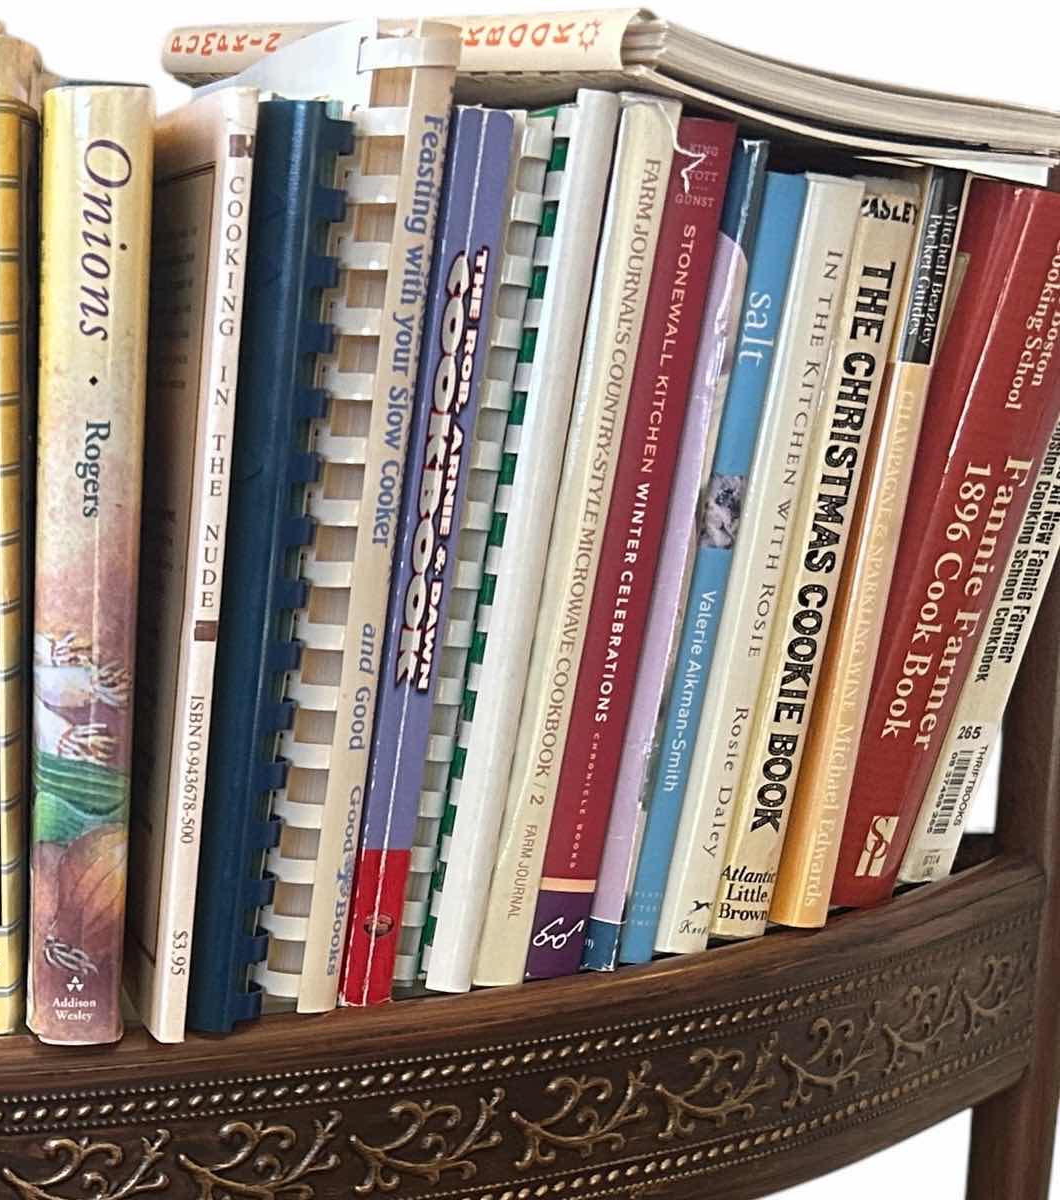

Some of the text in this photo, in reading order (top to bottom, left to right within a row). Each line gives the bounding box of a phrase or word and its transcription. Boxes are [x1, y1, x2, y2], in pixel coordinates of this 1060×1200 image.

[79, 138, 133, 342] Onions
[675, 193, 716, 208] GUNST
[738, 291, 775, 370] salt
[908, 214, 942, 337] Pocket Guides
[74, 419, 111, 519] Rogers
[594, 224, 697, 723] STONEWALL KITCHEN WINTER CELEBRATIONS
[747, 251, 843, 658] IN THE KITCHEN WITH ROSIE
[750, 260, 897, 834] THE CHRISTMAS COOKIE BOOK
[964, 455, 1034, 597] Fannie
[880, 461, 992, 740] 1896 Cook Book
[348, 622, 376, 751] and Good
[914, 607, 982, 752] Farmer
[957, 725, 983, 741] 265
[702, 705, 750, 860] Rosie Daley
[507, 823, 538, 921] FARM JOURNAL
[718, 903, 769, 921] Brown
[720, 864, 776, 885] Atlantic
[52, 997, 98, 1009] Addison
[170, 929, 189, 977] $3.95
[55, 1010, 95, 1023] Wesley
